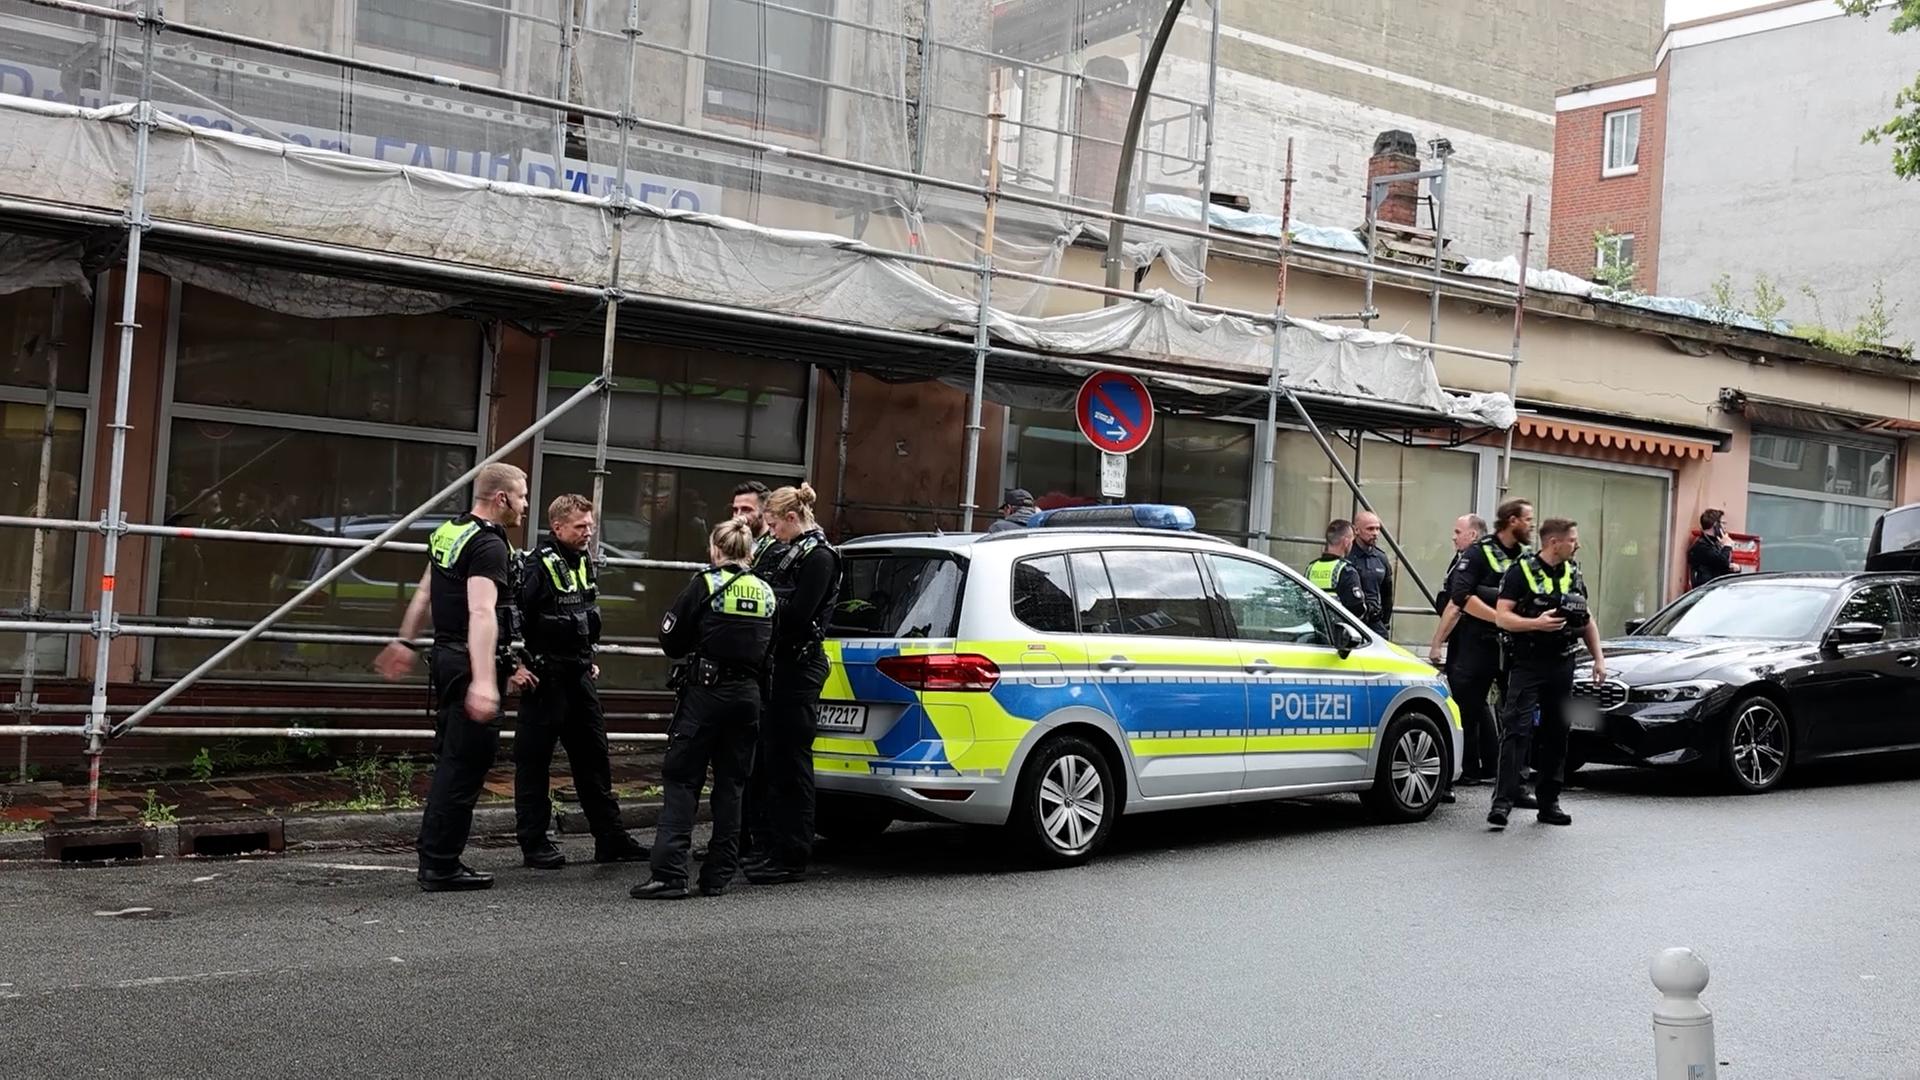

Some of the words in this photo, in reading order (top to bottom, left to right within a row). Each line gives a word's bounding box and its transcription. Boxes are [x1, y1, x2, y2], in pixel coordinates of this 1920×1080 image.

[726, 584, 765, 600] POLIZEI
[828, 706, 859, 725] 7217
[1271, 692, 1351, 720] POLIZEI
